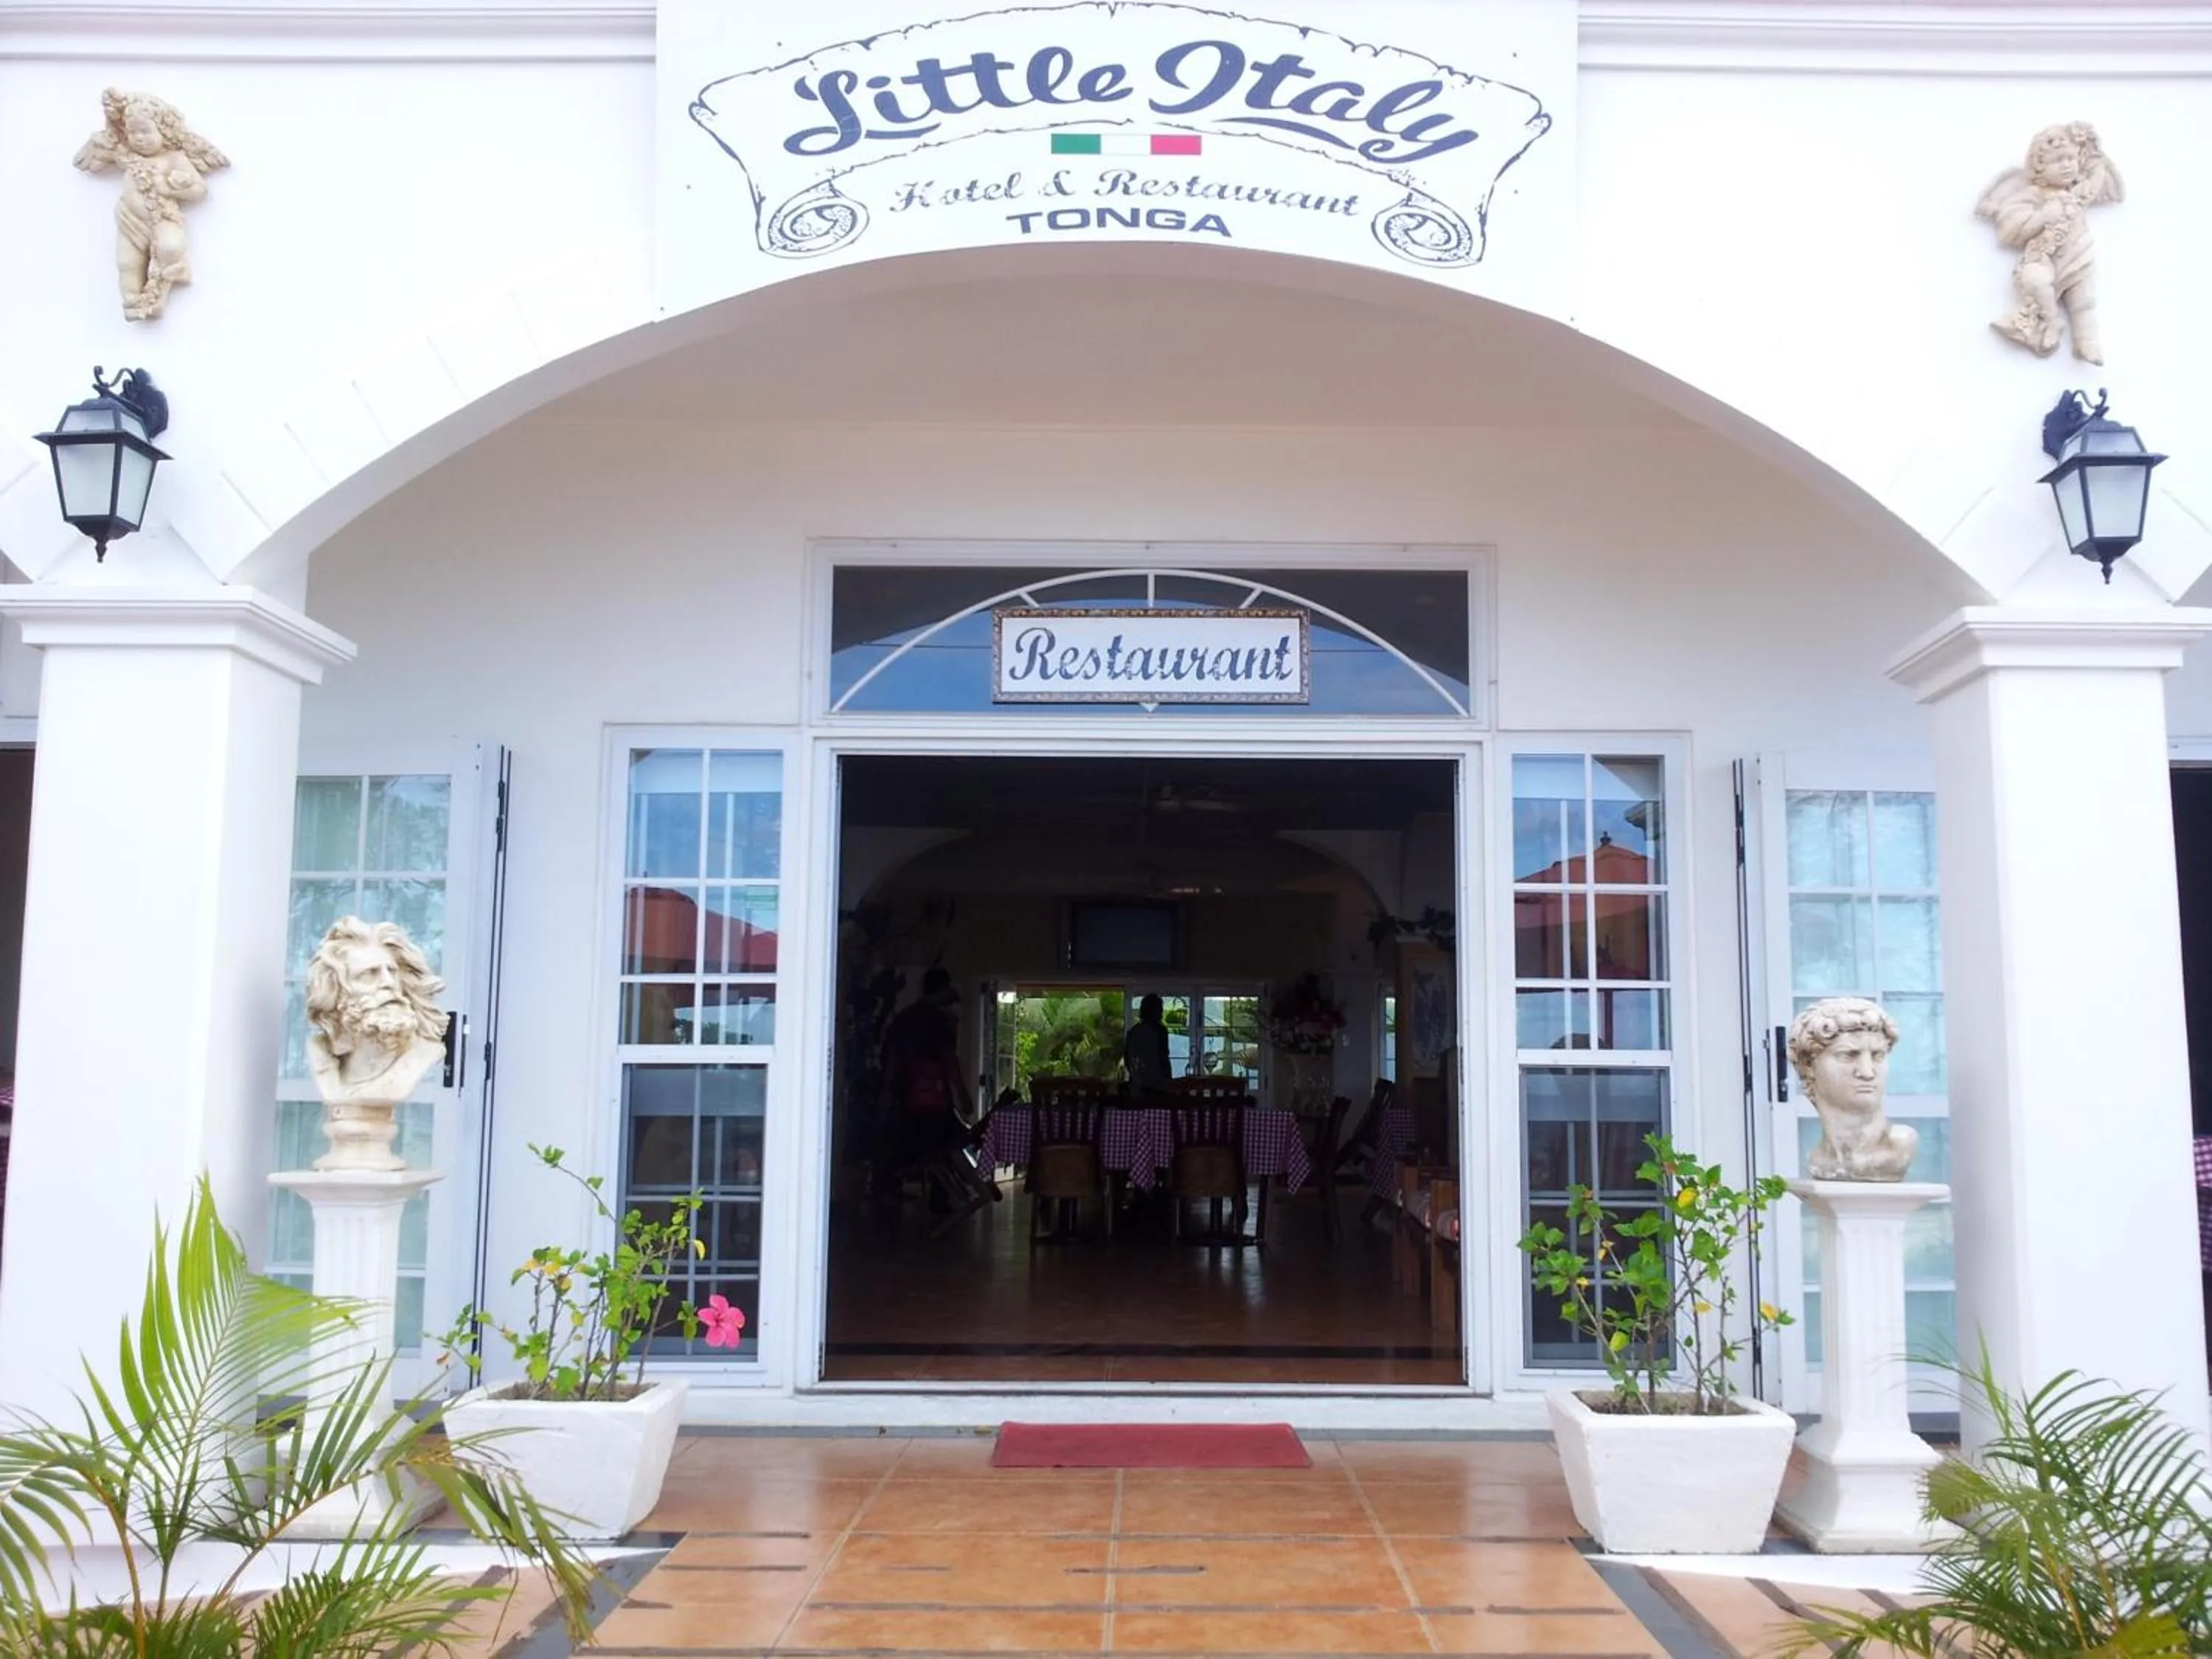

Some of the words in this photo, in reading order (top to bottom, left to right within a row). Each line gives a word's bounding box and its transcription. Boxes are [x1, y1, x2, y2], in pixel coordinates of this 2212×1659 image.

[783, 46, 1134, 156] Little
[1148, 40, 1478, 164] Italy
[889, 173, 1022, 212] Hotel
[1040, 170, 1076, 197] &
[1093, 170, 1360, 215] Restaurant
[1006, 208, 1231, 237] TONGA
[1009, 627, 1293, 681] Restaurant
